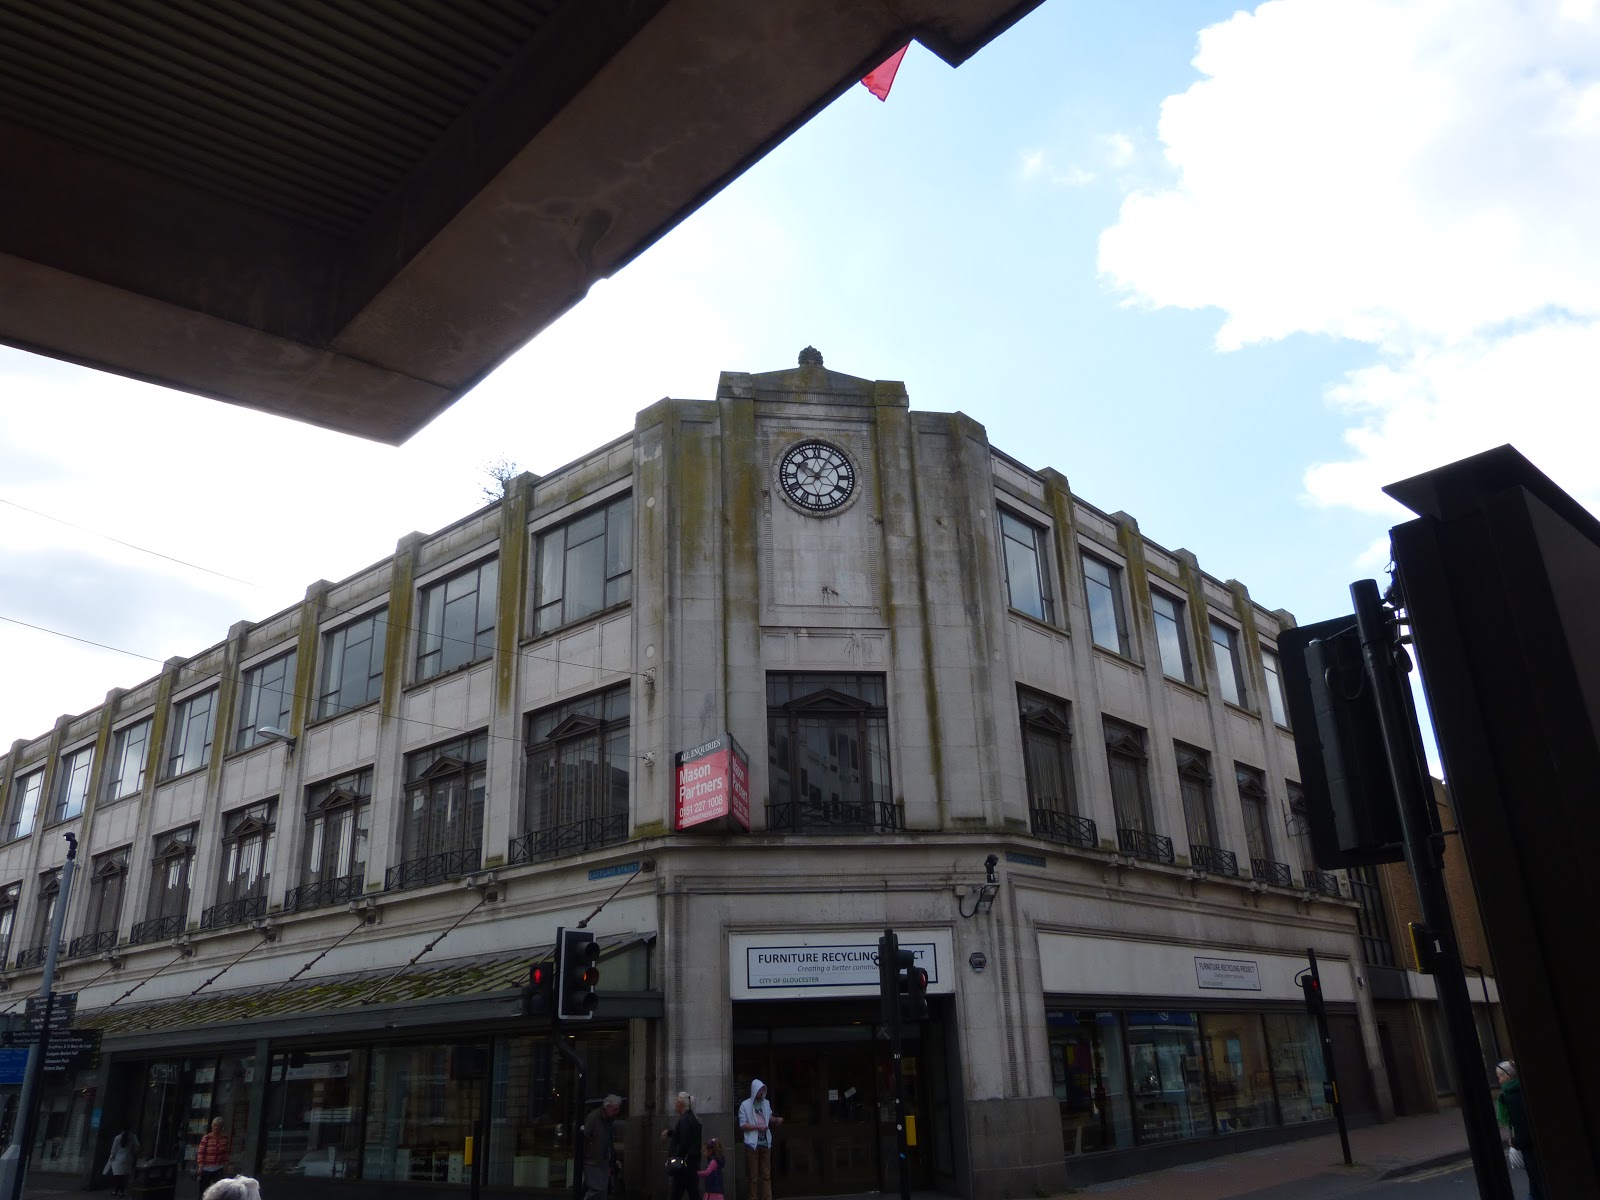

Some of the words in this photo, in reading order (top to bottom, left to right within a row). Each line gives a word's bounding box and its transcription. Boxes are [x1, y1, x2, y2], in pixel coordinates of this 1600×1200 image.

[691, 739, 721, 757] ENQUIRIES
[679, 763, 711, 786] Mason
[679, 776, 723, 803] Partners
[679, 804, 693, 818] 0151
[694, 800, 706, 813] 227
[707, 795, 723, 809] 1008
[590, 869, 616, 878] EASTGATE
[617, 863, 638, 874] STREET
[1433, 939, 1443, 953] 1
[758, 952, 819, 964] FURNITURE
[822, 951, 879, 963] RECYCLING
[1198, 962, 1221, 971] FURNITURE
[1221, 963, 1240, 973] RECYCLING
[782, 976, 819, 984] GLOUCESTER
